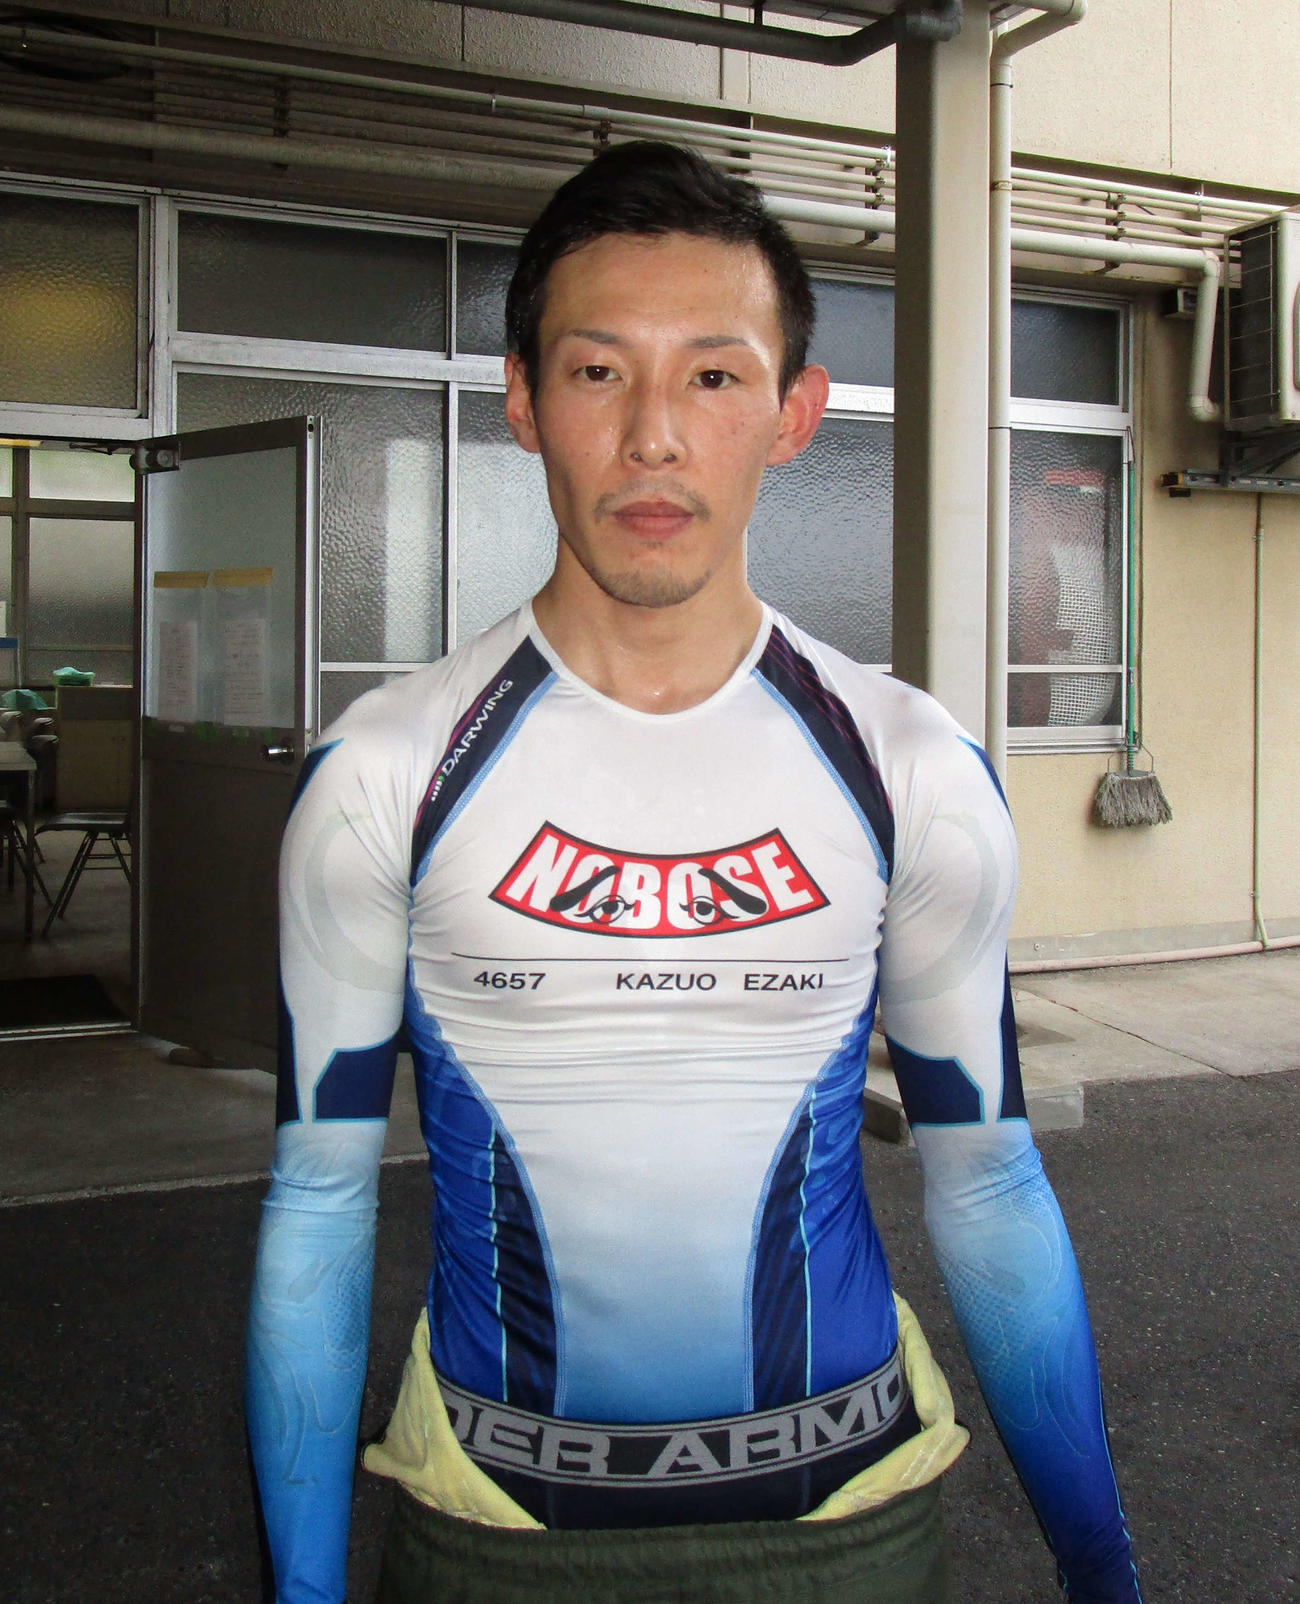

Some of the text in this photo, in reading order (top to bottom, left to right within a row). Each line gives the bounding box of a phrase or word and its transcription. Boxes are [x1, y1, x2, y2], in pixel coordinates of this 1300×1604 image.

[441, 678, 514, 777] DARWING
[504, 833, 815, 931] NOBOSE
[473, 971, 824, 991] 4657 KAZUO EZAKI
